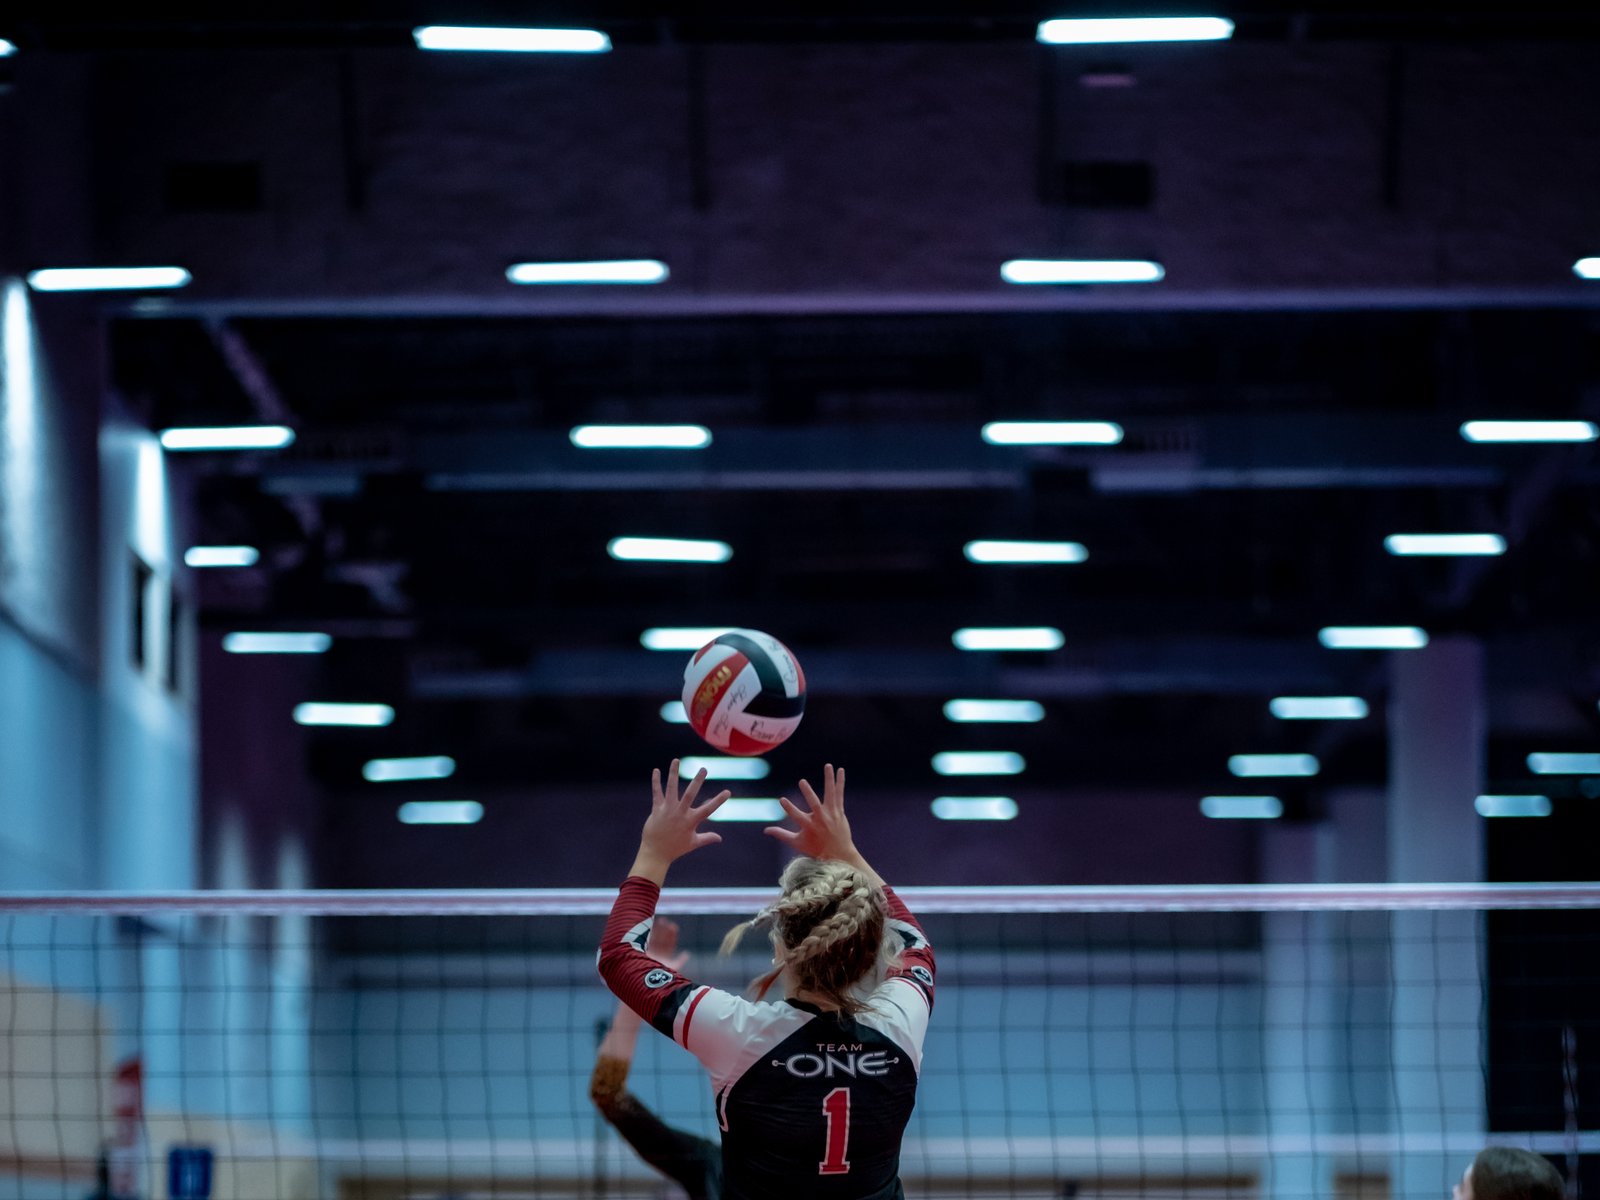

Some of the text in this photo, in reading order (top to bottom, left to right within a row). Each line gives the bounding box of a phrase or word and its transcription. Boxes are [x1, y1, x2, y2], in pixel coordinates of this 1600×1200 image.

[816, 1044, 863, 1053] TEAM
[786, 1050, 887, 1078] ONE
[819, 1087, 852, 1175] 1
